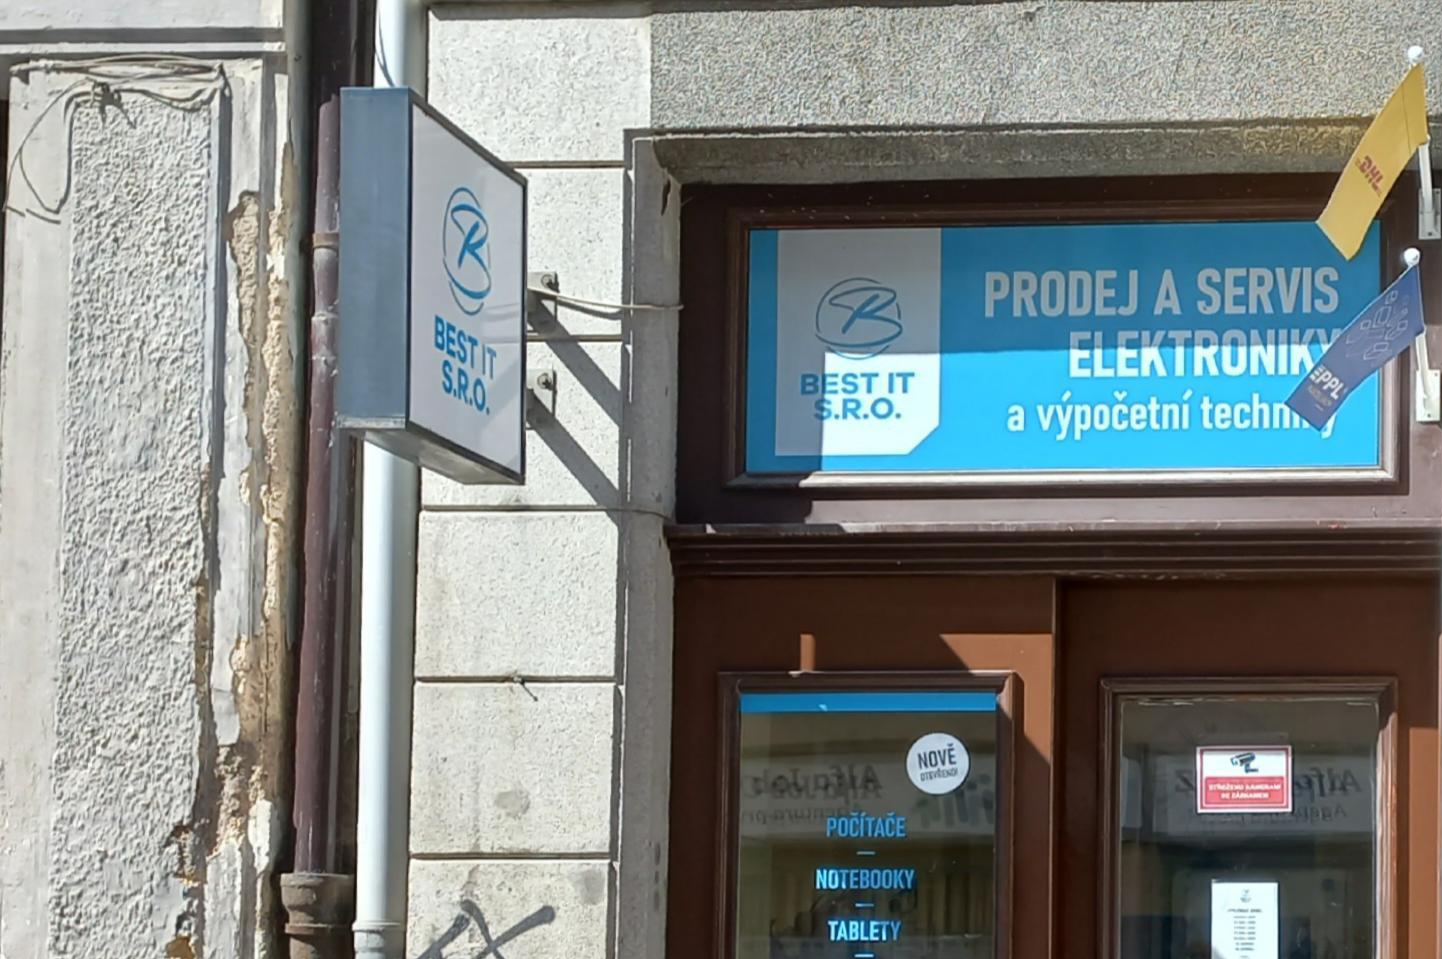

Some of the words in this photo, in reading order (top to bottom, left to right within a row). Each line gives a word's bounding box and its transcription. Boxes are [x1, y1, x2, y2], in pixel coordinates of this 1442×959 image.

[1358, 154, 1384, 193] DHL
[984, 269, 1138, 317] PRODEJ
[1153, 269, 1182, 315] A
[1196, 267, 1340, 315] SERVIS
[434, 314, 479, 369] BEST
[482, 343, 497, 380] IT
[442, 359, 490, 415] S.R.O.
[800, 373, 880, 395] BEST
[888, 372, 915, 394] IT
[814, 397, 902, 421] S.R.O.
[1007, 404, 1025, 431] a
[1037, 389, 1193, 441] výpočetní
[917, 742, 957, 770] NOVĚ
[826, 811, 907, 838] POČÍTAČE
[815, 868, 915, 890] NOTEBOOKY
[828, 920, 901, 942] TABLETY
